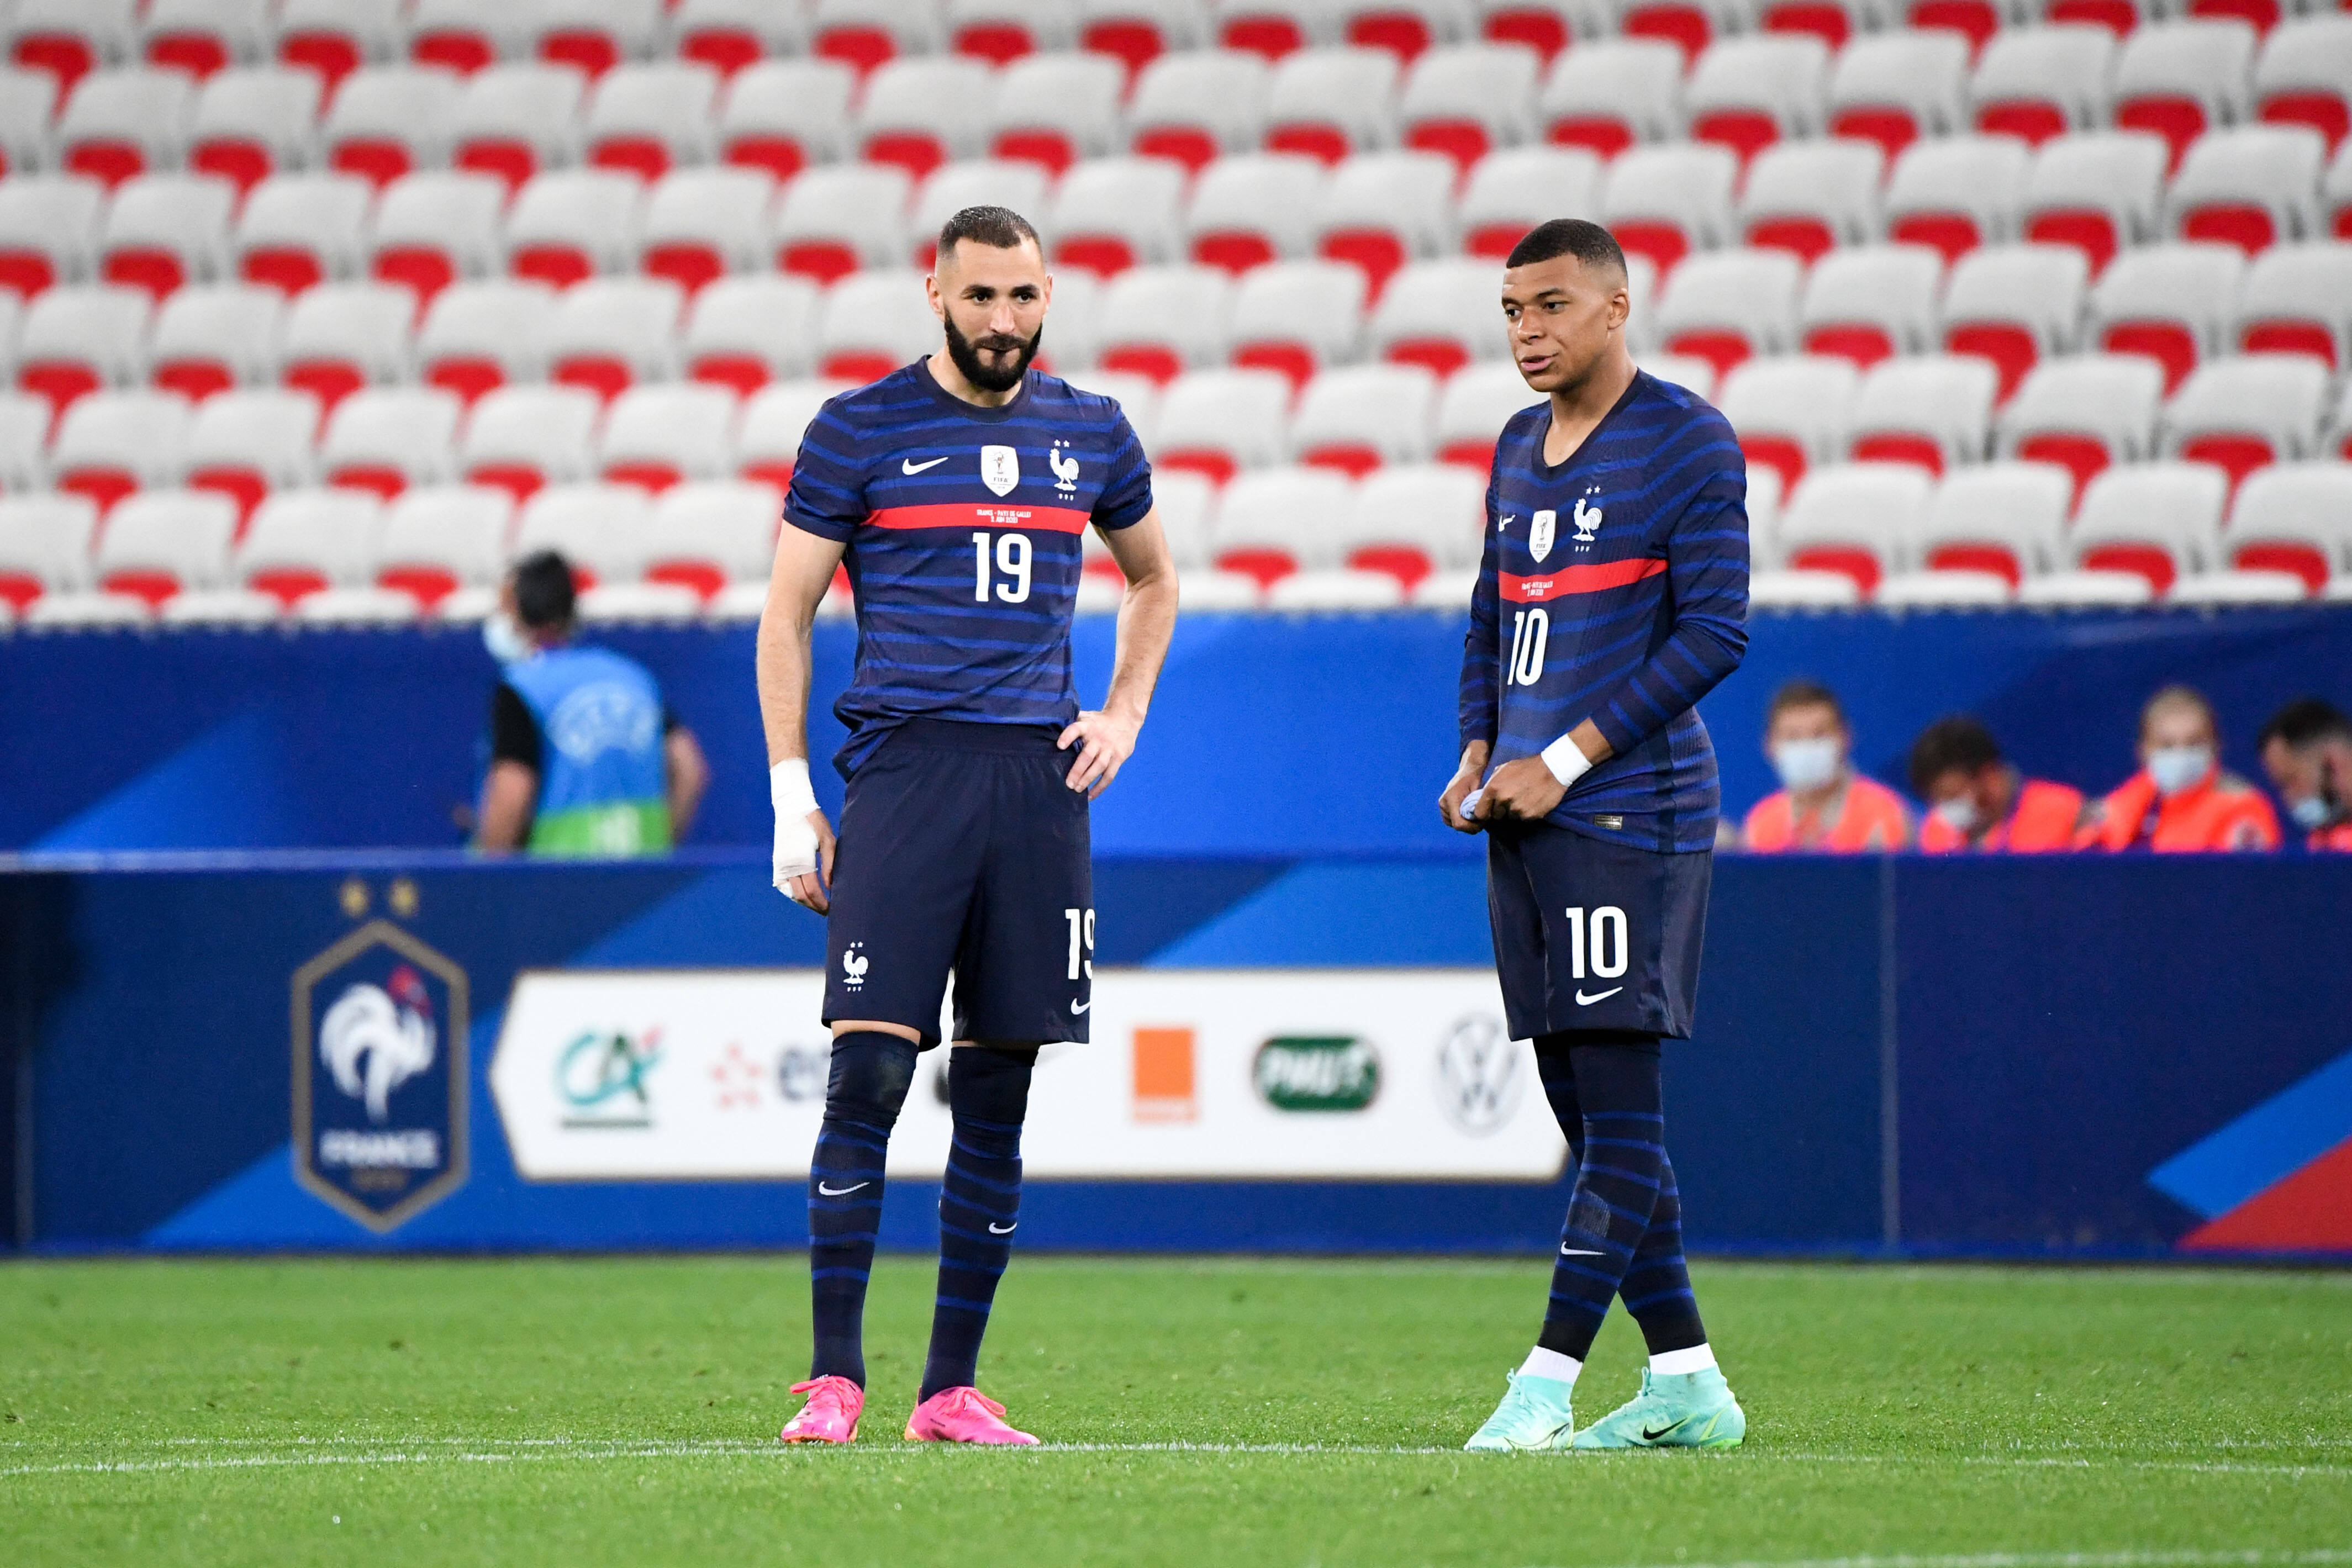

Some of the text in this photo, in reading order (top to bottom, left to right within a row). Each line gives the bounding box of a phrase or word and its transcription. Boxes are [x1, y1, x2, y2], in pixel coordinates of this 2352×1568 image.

[973, 532, 1032, 603] 19
[1507, 608, 1548, 685] 10
[1065, 909, 1095, 979] 19
[1566, 906, 1628, 979] 10
